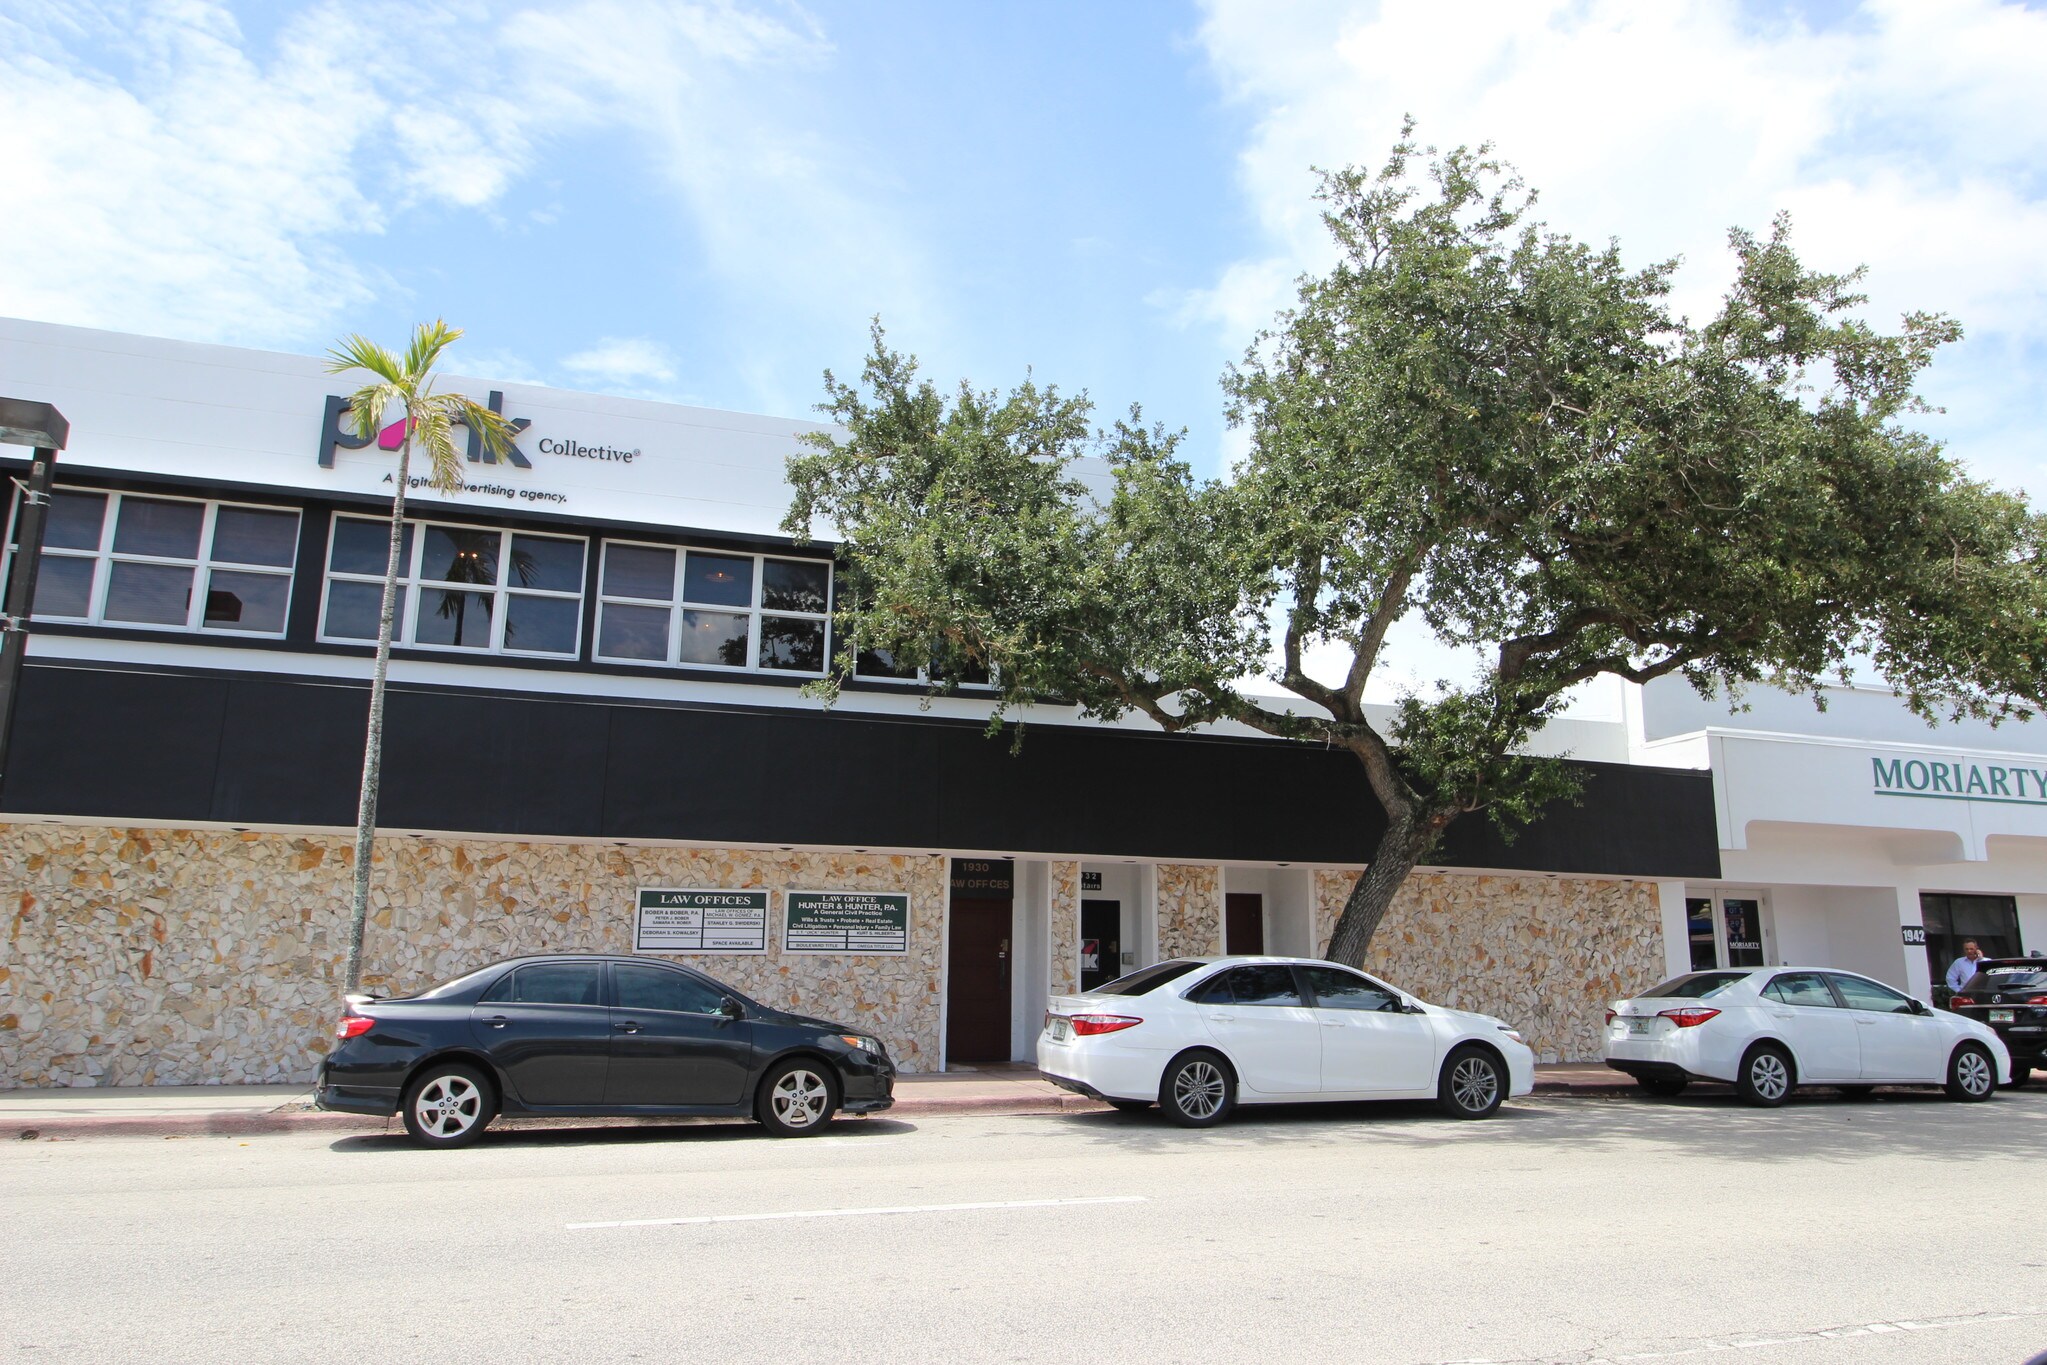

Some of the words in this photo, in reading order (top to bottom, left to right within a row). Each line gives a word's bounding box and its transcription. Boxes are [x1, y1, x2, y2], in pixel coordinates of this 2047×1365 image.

[383, 473, 393, 483] A
[446, 480, 516, 499] dvertising
[519, 490, 567, 504] agency.
[1871, 757, 2047, 799] MORIARTY
[963, 862, 989, 872] 1930
[661, 894, 691, 904] LAW
[694, 895, 751, 905] OFFICES
[845, 903, 883, 911] HUNTER,
[1902, 929, 1925, 942] 1942
